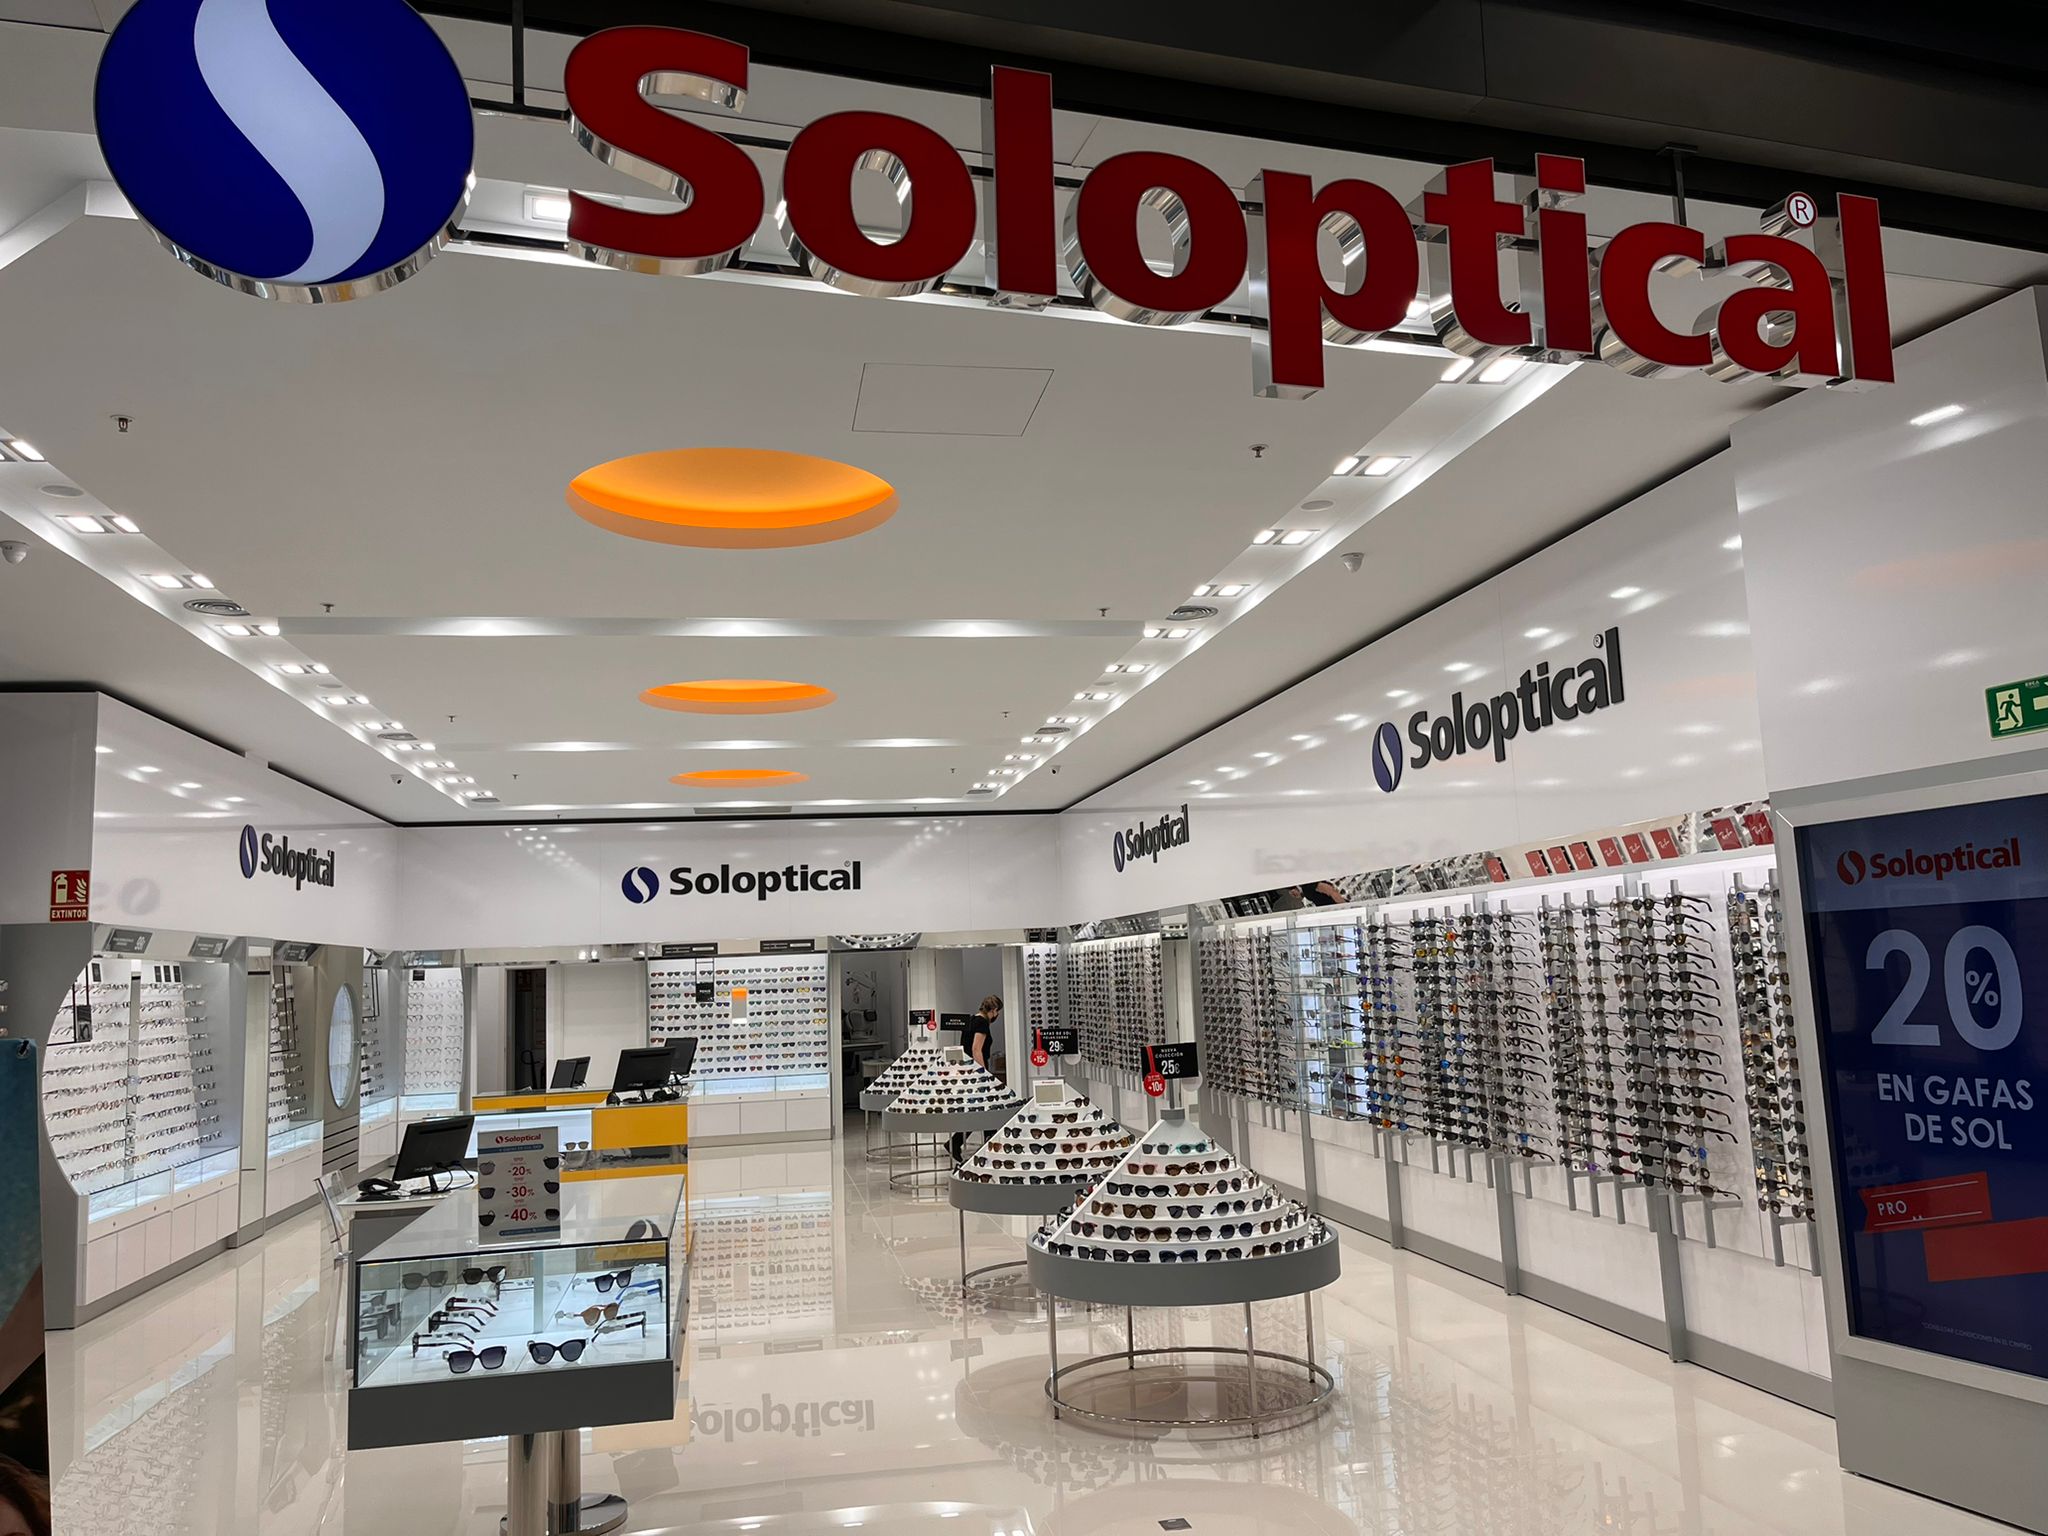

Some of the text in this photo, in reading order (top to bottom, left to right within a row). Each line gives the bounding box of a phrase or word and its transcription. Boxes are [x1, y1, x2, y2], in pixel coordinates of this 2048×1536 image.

[564, 25, 1896, 388] Soloptical
[1407, 626, 1625, 763] Soloptical
[1125, 803, 1189, 864] Soloptical
[260, 832, 335, 891] Soloptical
[1870, 837, 2021, 881] Soloptical
[669, 860, 861, 901] Soloptical
[51, 909, 87, 919] EXTINTOR
[1876, 1072, 2034, 1111] EN GAFAS
[504, 1134, 542, 1143] Soloptical
[1904, 1112, 2013, 1150] DE SOL
